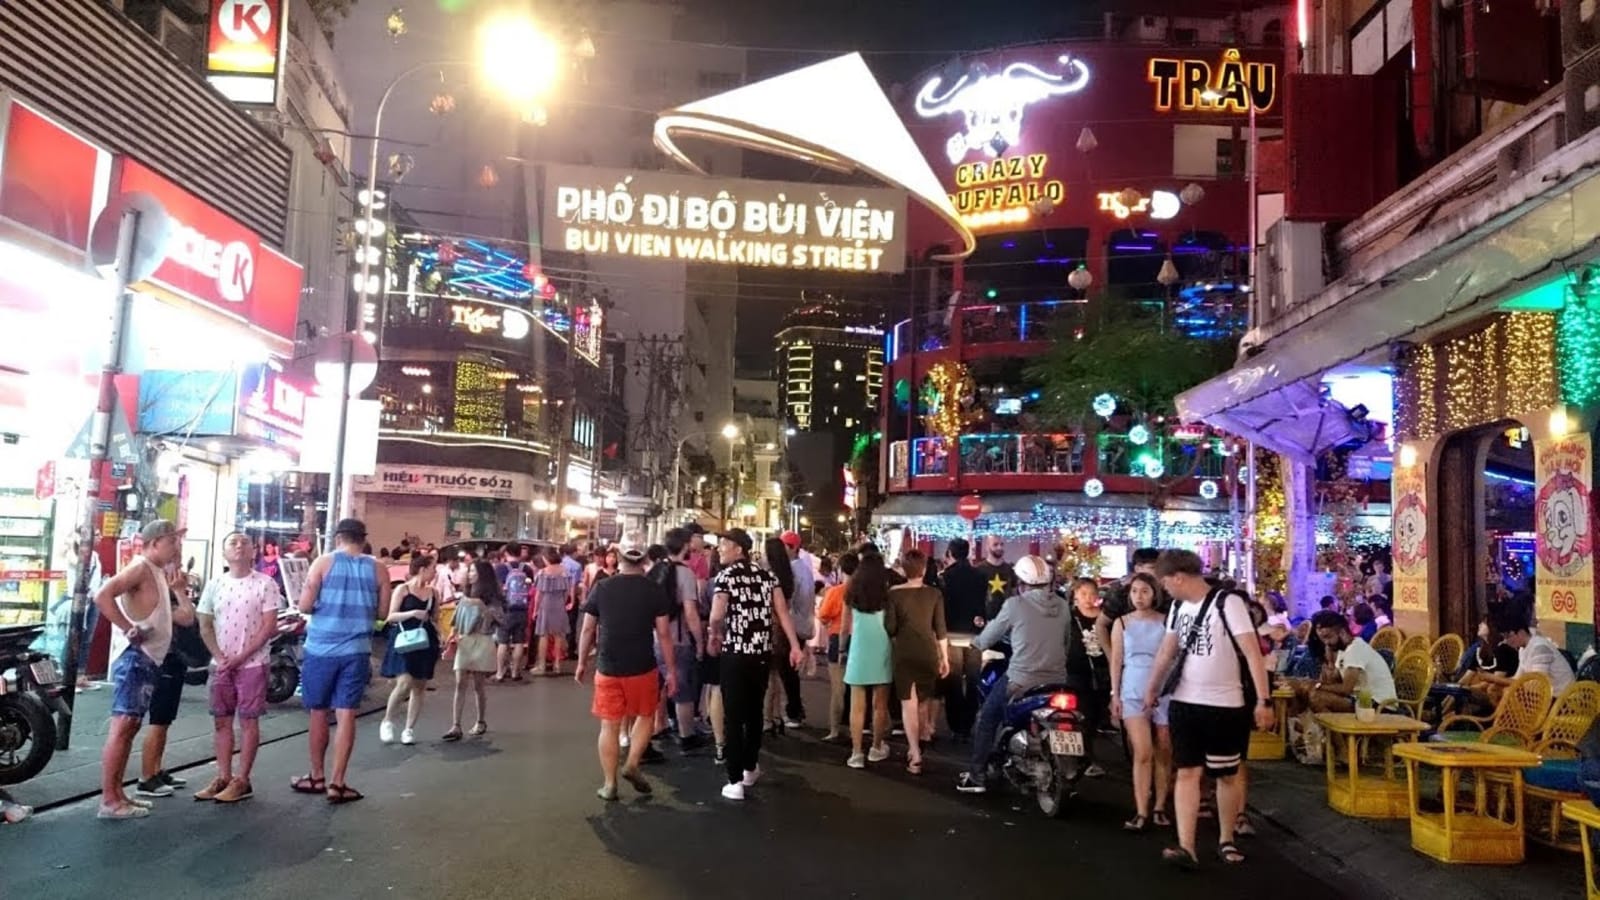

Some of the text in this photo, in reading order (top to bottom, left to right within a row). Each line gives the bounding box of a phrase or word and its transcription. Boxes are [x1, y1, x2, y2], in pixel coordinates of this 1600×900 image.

[1149, 48, 1277, 113] TRÂU
[955, 154, 1046, 185] CRAZY
[557, 176, 895, 250] PHỐ ĐI BỘ BÙI VIỆN
[565, 227, 884, 271] BUI VIEN WALKING STREET
[452, 305, 501, 333] Tiger
[500, 479, 513, 488] 22
